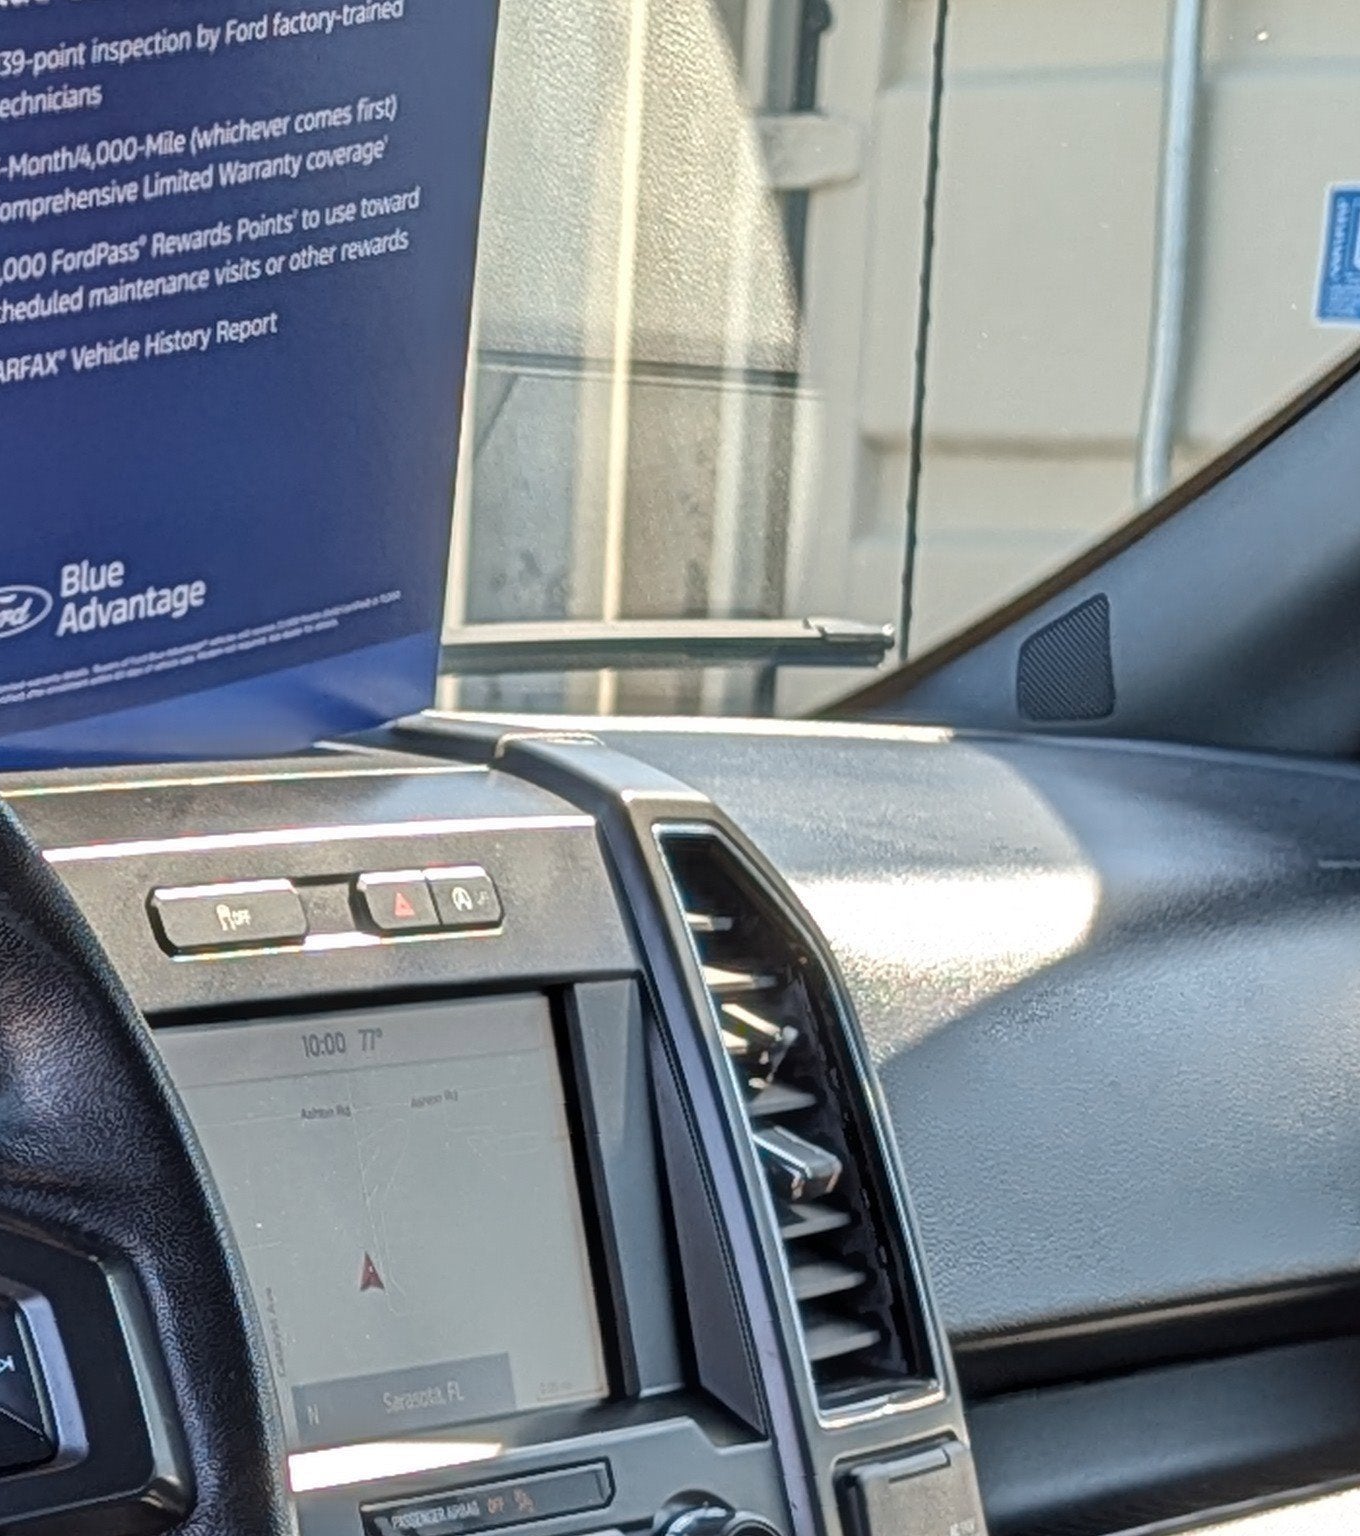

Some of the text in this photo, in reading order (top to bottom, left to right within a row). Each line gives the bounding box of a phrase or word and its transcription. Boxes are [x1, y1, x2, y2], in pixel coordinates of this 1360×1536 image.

[91, 28, 191, 63] inspection
[196, 23, 221, 55] by
[224, 14, 268, 45] Ford
[272, 0, 404, 36] factory-trained
[190, 115, 290, 155] (whichever
[294, 103, 352, 133] comes
[356, 94, 397, 122] first)
[143, 164, 213, 200] Limited
[219, 153, 302, 187] Warranty
[152, 221, 231, 258] Rewards
[302, 209, 320, 231] to
[325, 201, 357, 226] use
[361, 185, 421, 219] toward
[89, 268, 209, 309] maintenance
[215, 257, 261, 286] visits
[265, 254, 285, 275] or
[290, 244, 336, 271] other
[341, 227, 409, 261] rewards
[72, 337, 140, 372] Vehicle
[145, 325, 212, 357] History
[216, 312, 277, 343] Report
[60, 559, 125, 598] Blue
[55, 580, 206, 638] Advantage
[302, 1031, 346, 1058] 10:00
